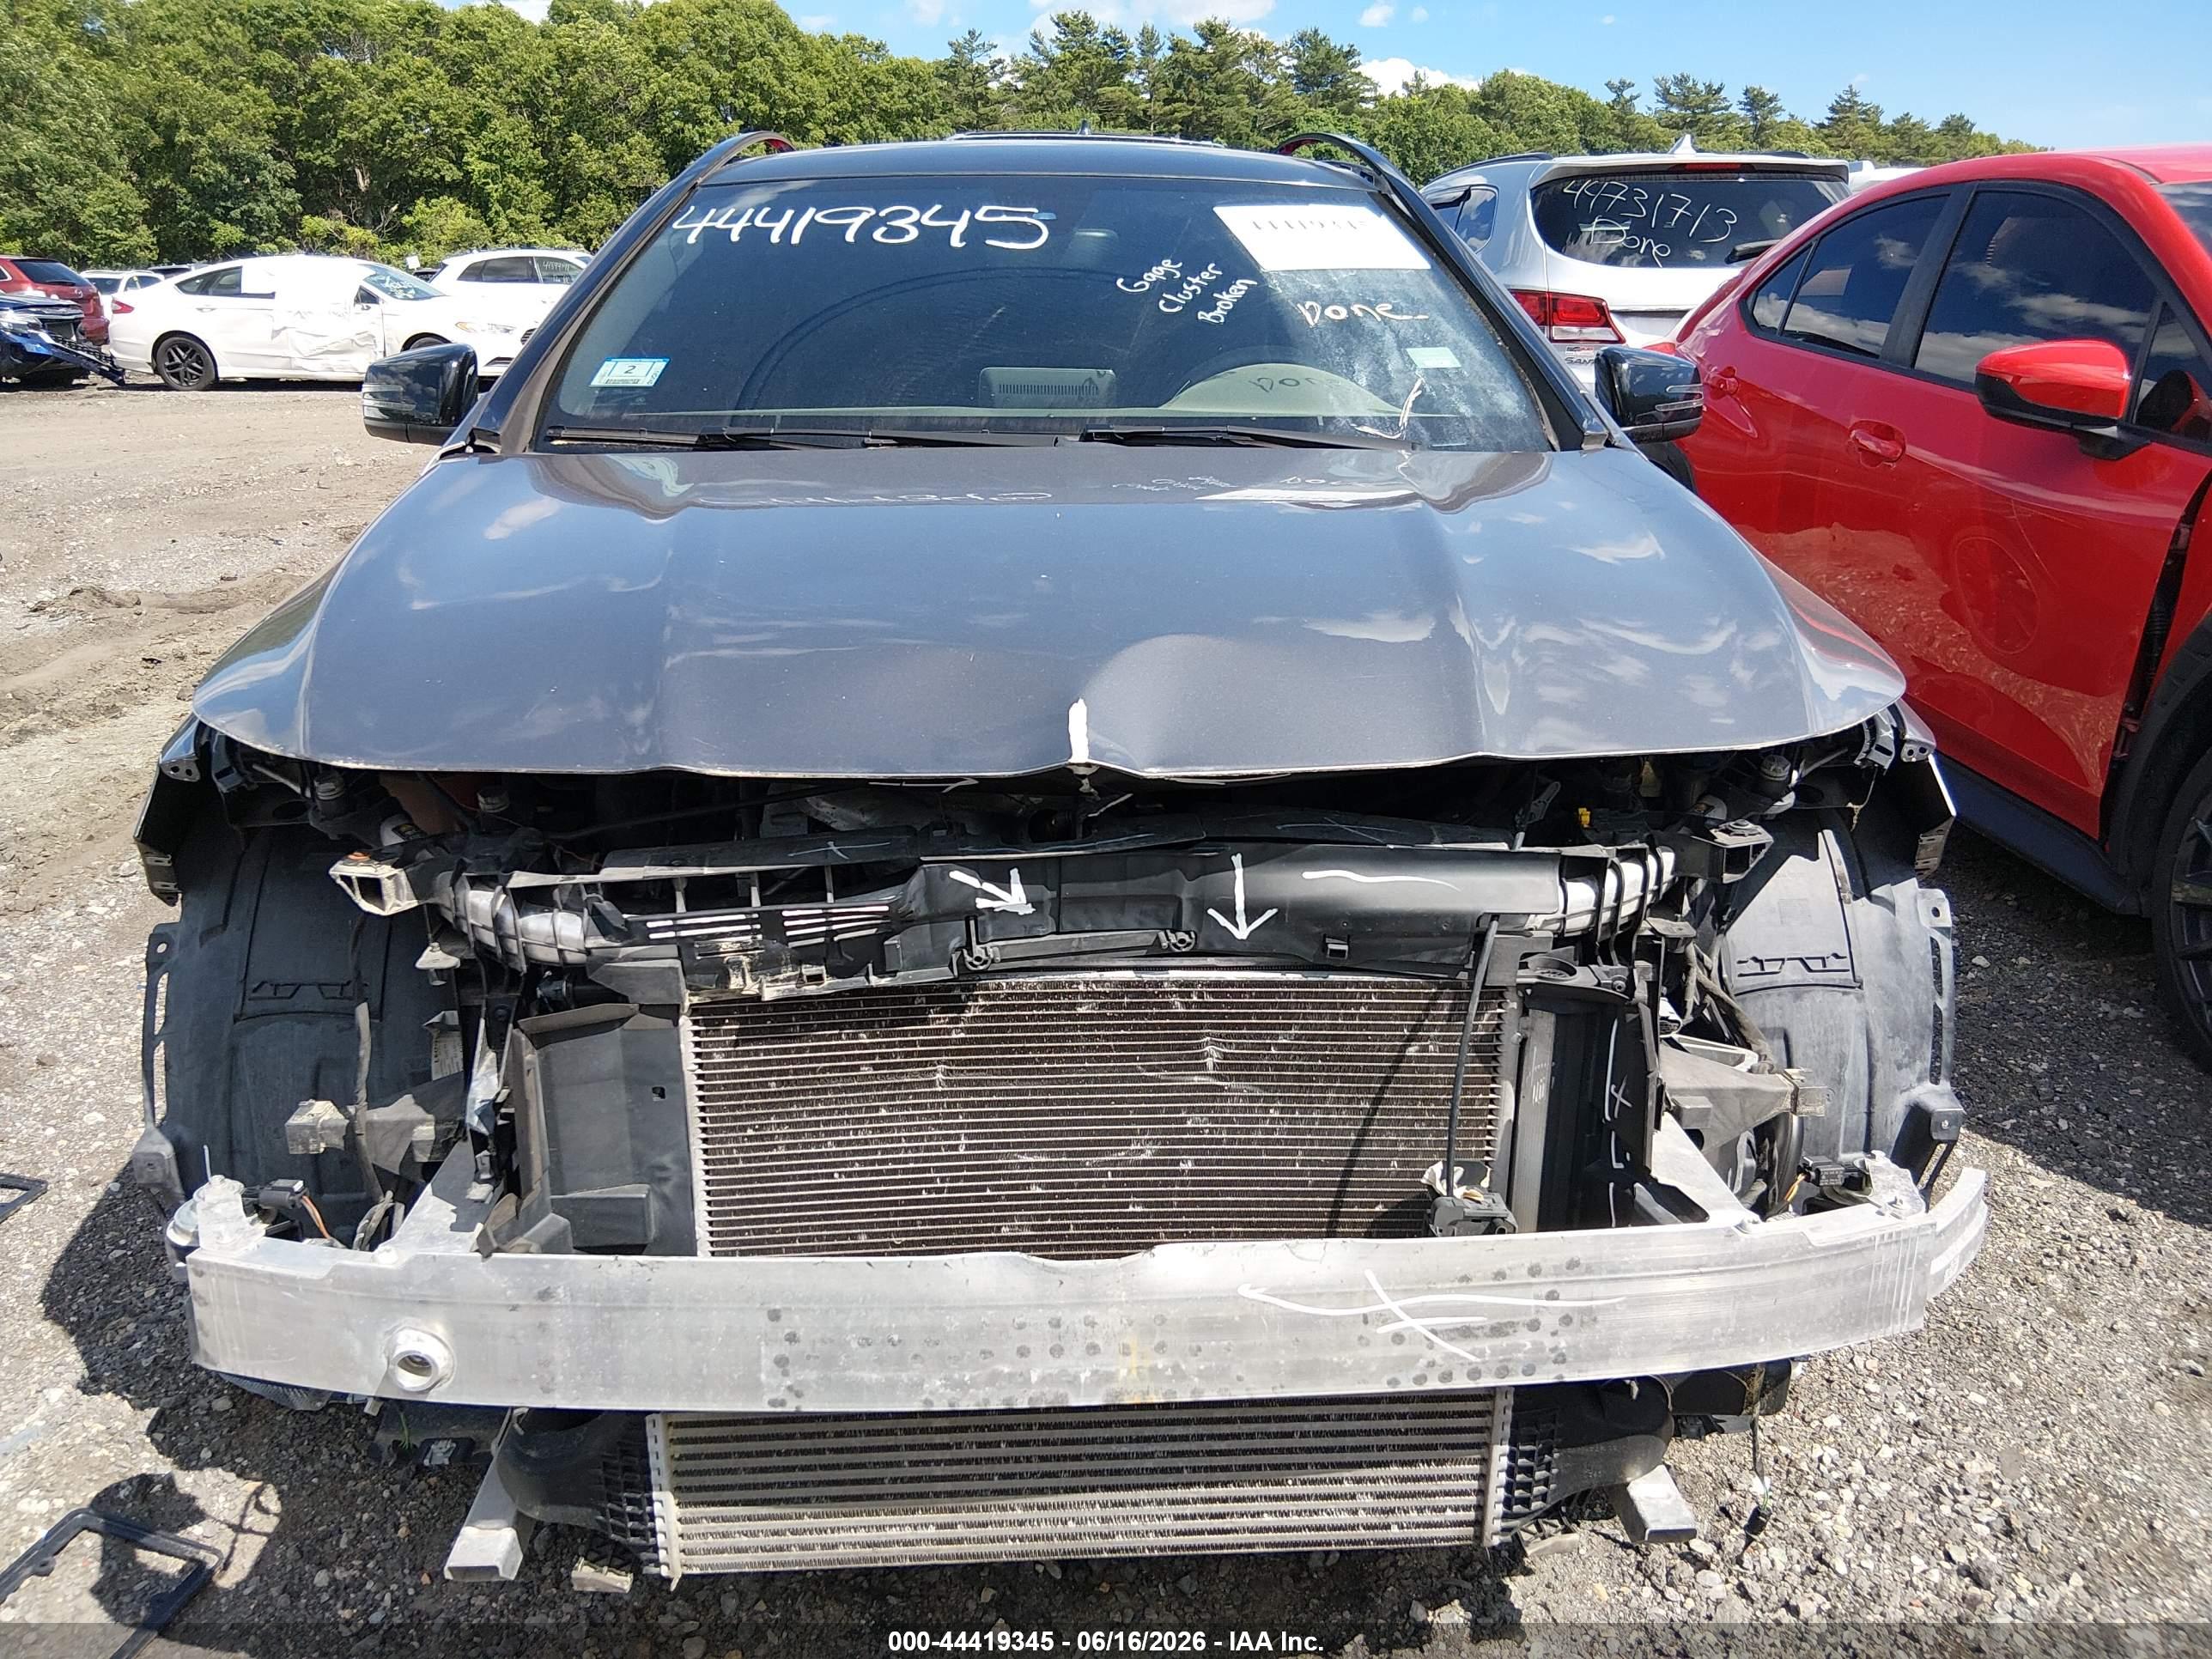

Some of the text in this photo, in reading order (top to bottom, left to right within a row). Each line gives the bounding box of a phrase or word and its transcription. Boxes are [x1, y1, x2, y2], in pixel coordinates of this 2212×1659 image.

[672, 204, 1048, 249] 44419345
[1116, 259, 1182, 293] Gage
[1159, 263, 1223, 313] Cluster
[1197, 279, 1257, 324] Broken
[623, 365, 636, 374] 2
